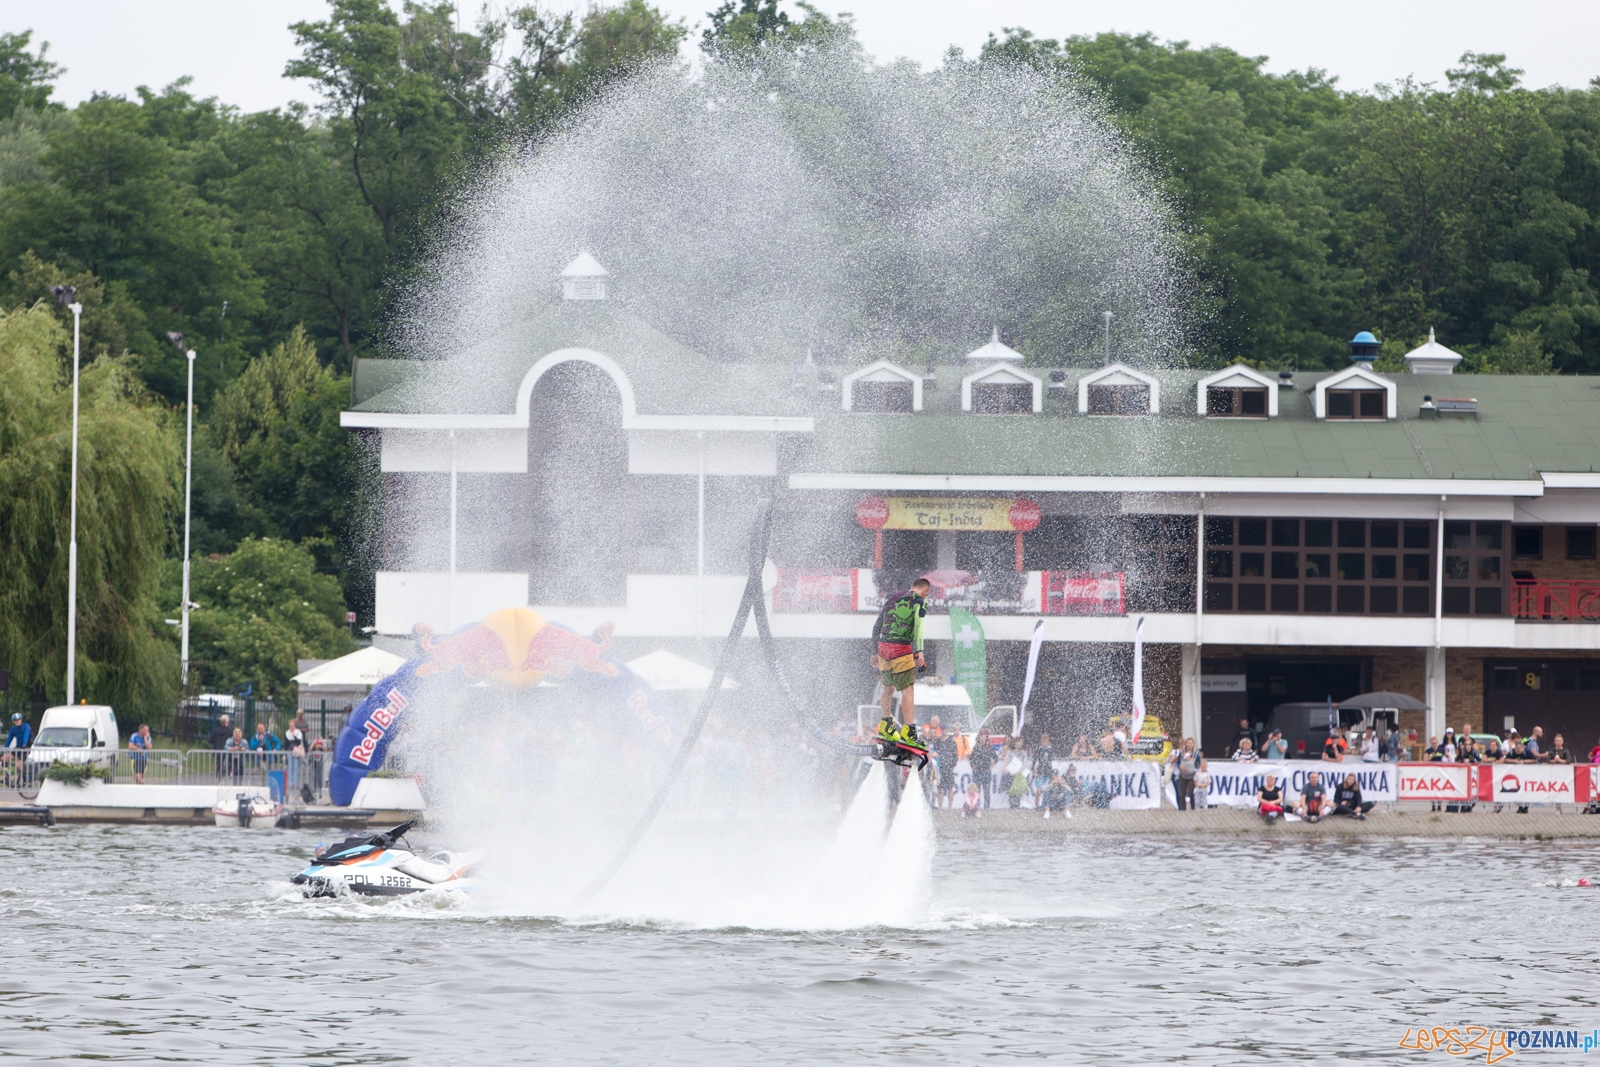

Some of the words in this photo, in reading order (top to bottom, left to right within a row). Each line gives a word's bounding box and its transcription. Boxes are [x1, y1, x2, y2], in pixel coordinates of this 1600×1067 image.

[1525, 672, 1537, 687] 8
[350, 722, 384, 764] Red
[371, 689, 408, 729] Bull
[1401, 777, 1456, 791] ITAKA
[1523, 780, 1570, 793] ITAKA
[380, 875, 412, 888] 12562
